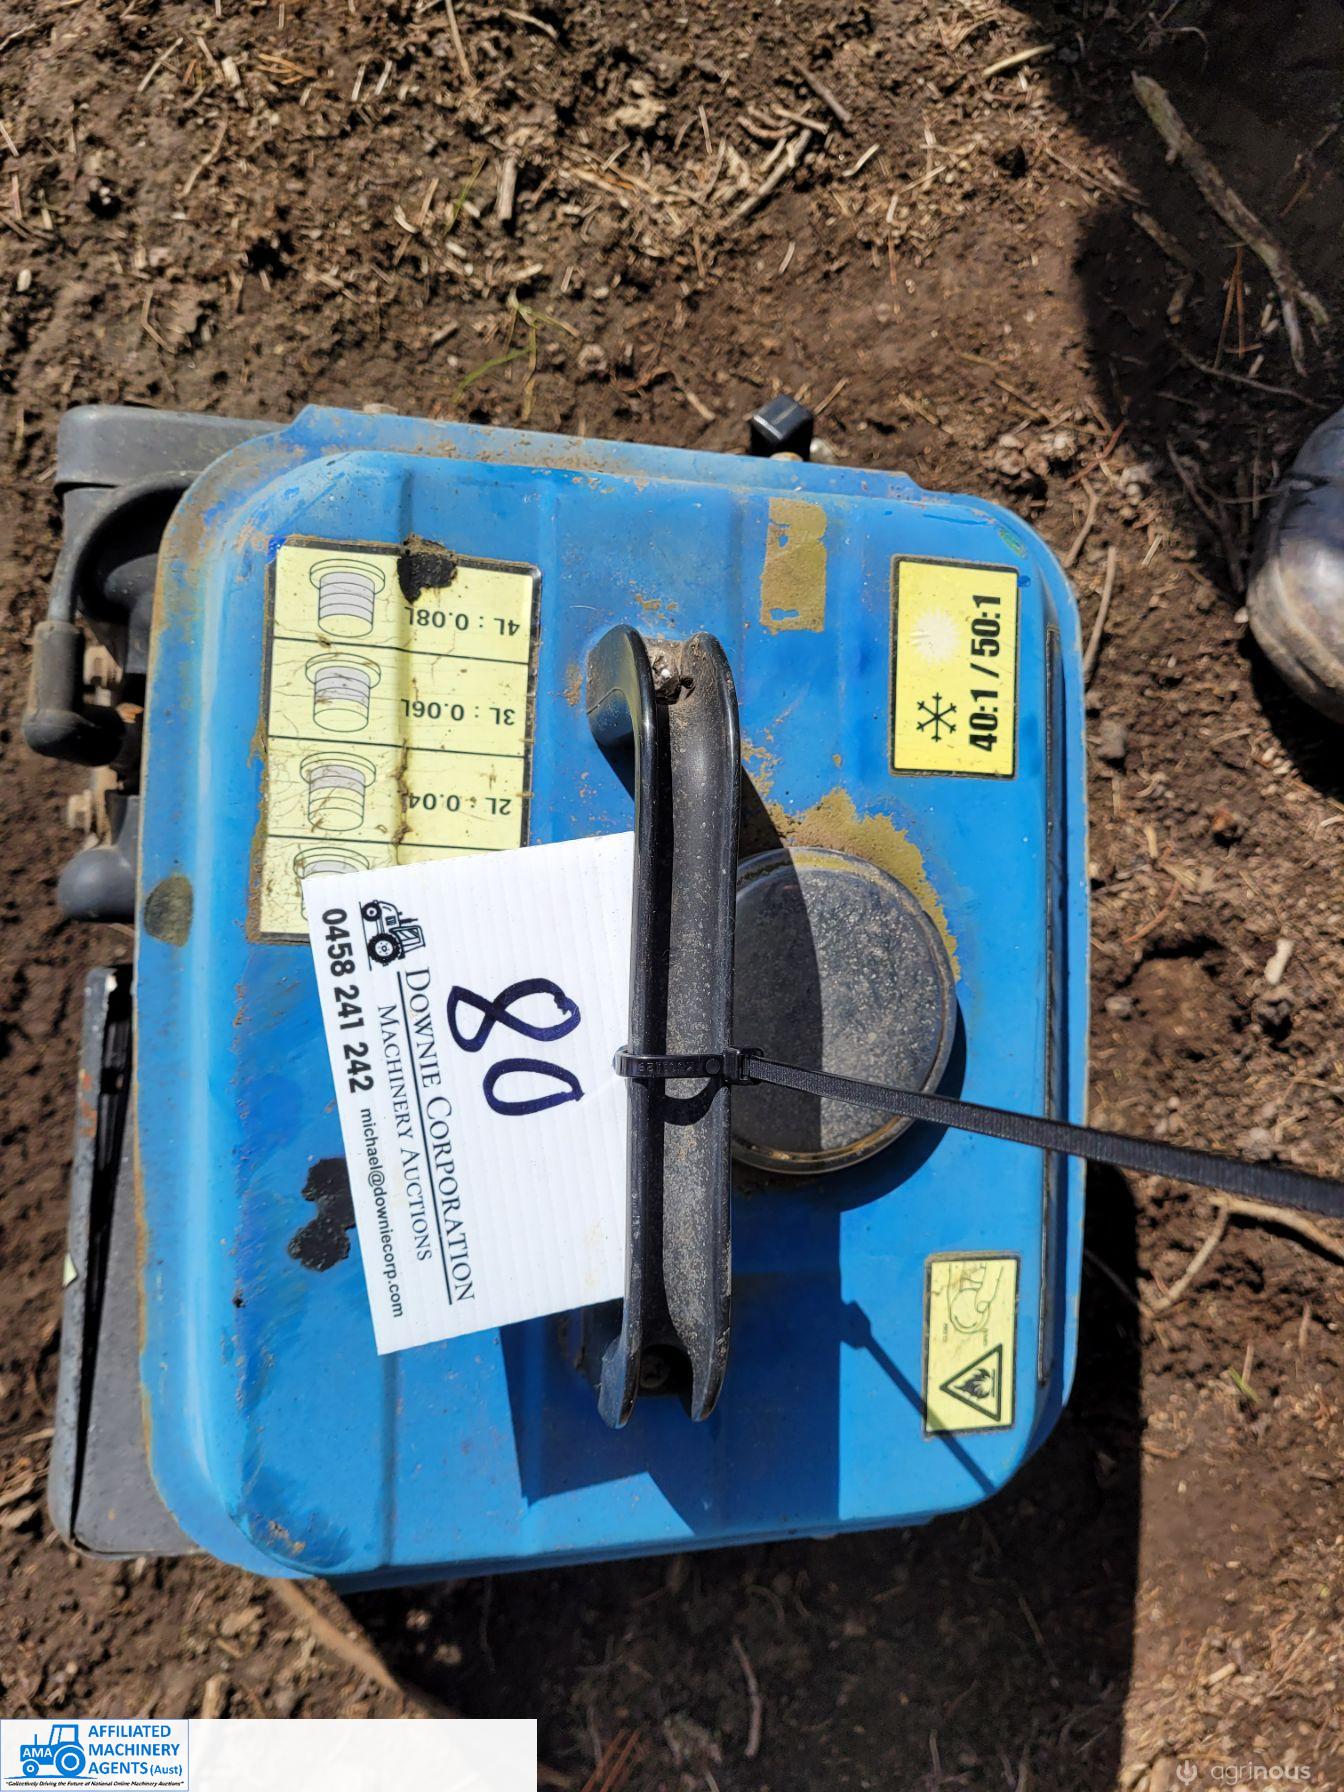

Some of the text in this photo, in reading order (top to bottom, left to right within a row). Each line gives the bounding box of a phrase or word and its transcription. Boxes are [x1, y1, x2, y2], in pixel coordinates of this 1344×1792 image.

[405, 606, 469, 632] 0.08L
[495, 618, 521, 637] 4L
[401, 698, 465, 722] 0.06L
[969, 594, 1001, 752] 40:1 / 50:1
[490, 707, 516, 726] 3L
[402, 793, 460, 812] 0.04
[486, 797, 512, 816] 2L
[322, 908, 375, 1094] 0458 241 242
[446, 976, 586, 1117] 80
[377, 1004, 432, 1262] MACHINERY AUCTIONS
[405, 966, 476, 1302] DOWNIE CORPORATION
[360, 1107, 404, 1319] michael@downiecorp.com
